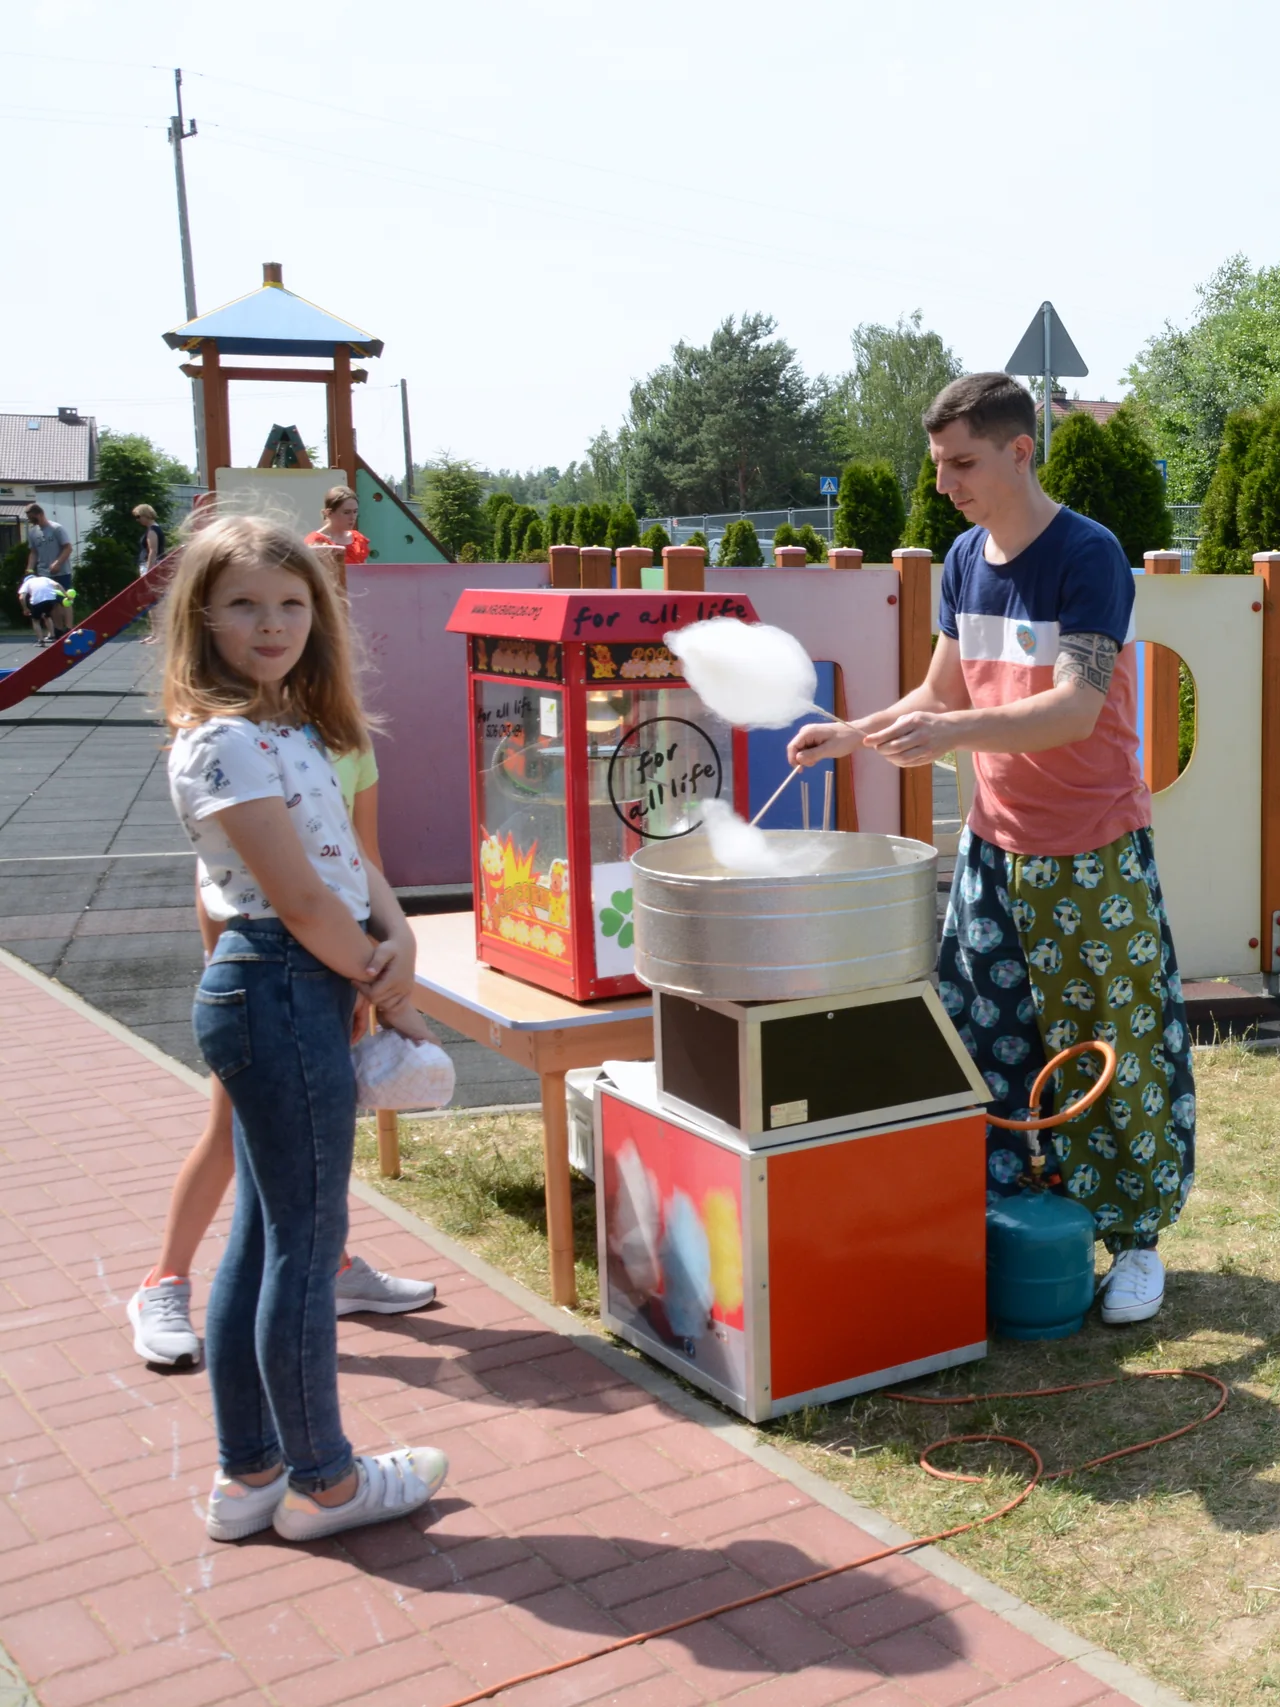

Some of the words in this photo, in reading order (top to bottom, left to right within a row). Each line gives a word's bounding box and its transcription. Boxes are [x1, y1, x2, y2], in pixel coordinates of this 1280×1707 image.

[573, 605, 621, 636] for
[639, 603, 679, 625] all
[697, 598, 748, 620] life
[476, 707, 492, 723] for
[496, 701, 509, 719] all
[514, 696, 533, 719] life
[636, 743, 678, 784] for
[629, 784, 664, 820] all
[671, 763, 716, 798] life
